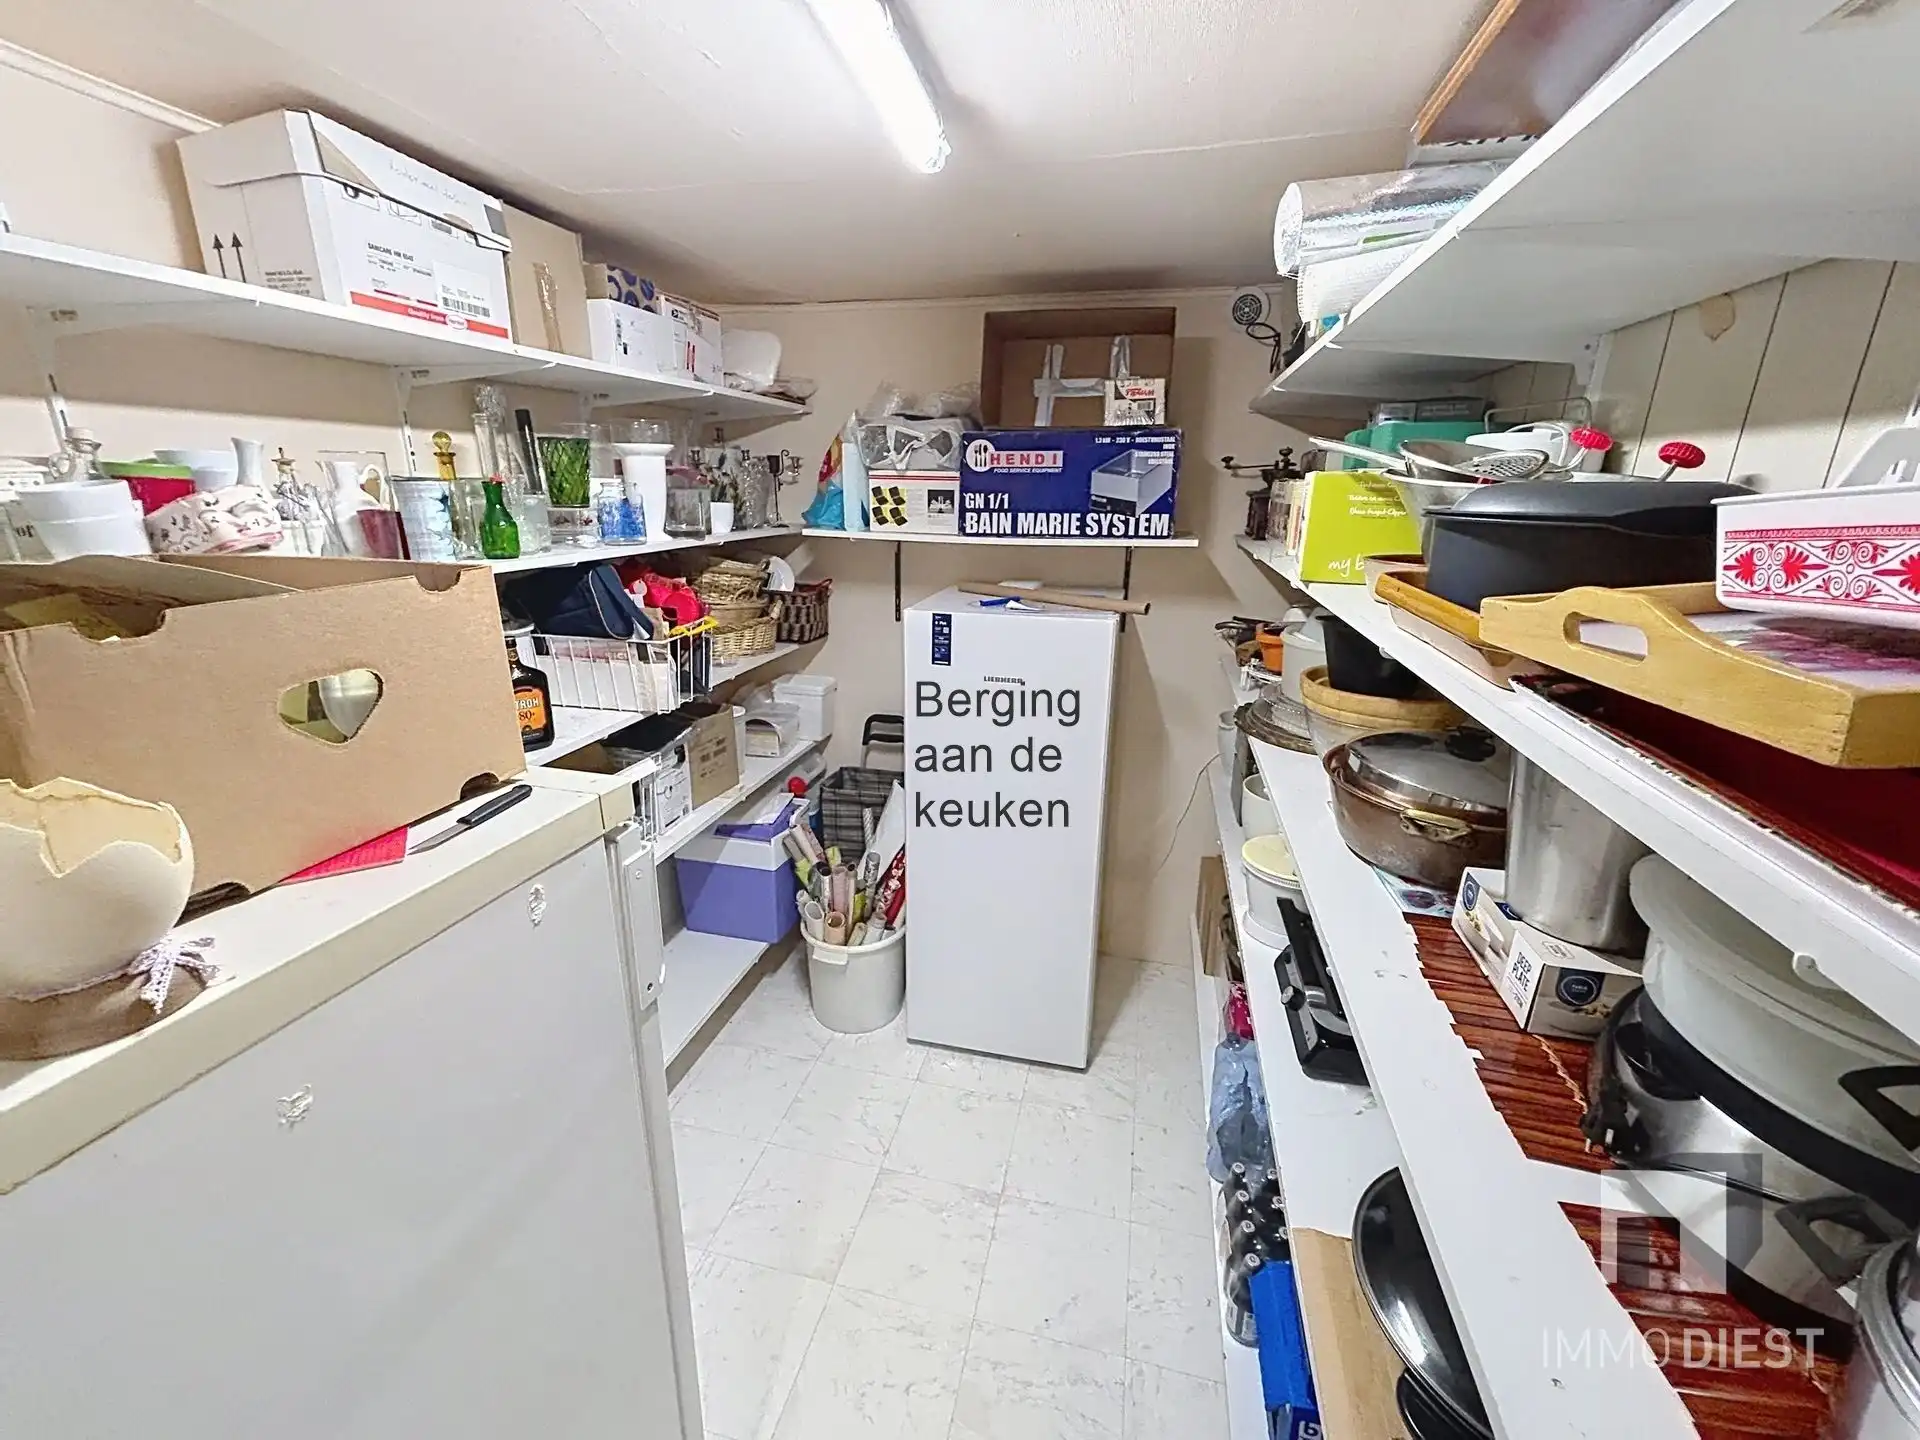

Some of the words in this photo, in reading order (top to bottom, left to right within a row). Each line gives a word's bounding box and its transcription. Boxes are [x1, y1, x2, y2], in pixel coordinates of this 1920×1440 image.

[990, 453, 1058, 466] HENDI
[966, 492, 986, 509] GN
[988, 492, 1009, 509] 1/1
[965, 512, 1012, 535] BAIN
[1017, 512, 1081, 535] MARIE
[1086, 513, 1170, 537] SYSTEM
[1328, 558, 1351, 577] my
[983, 675, 1023, 684] LIEBHERR
[514, 697, 540, 710] TROH
[1516, 951, 1532, 974] DEEP
[1512, 963, 1530, 992] PLATE
